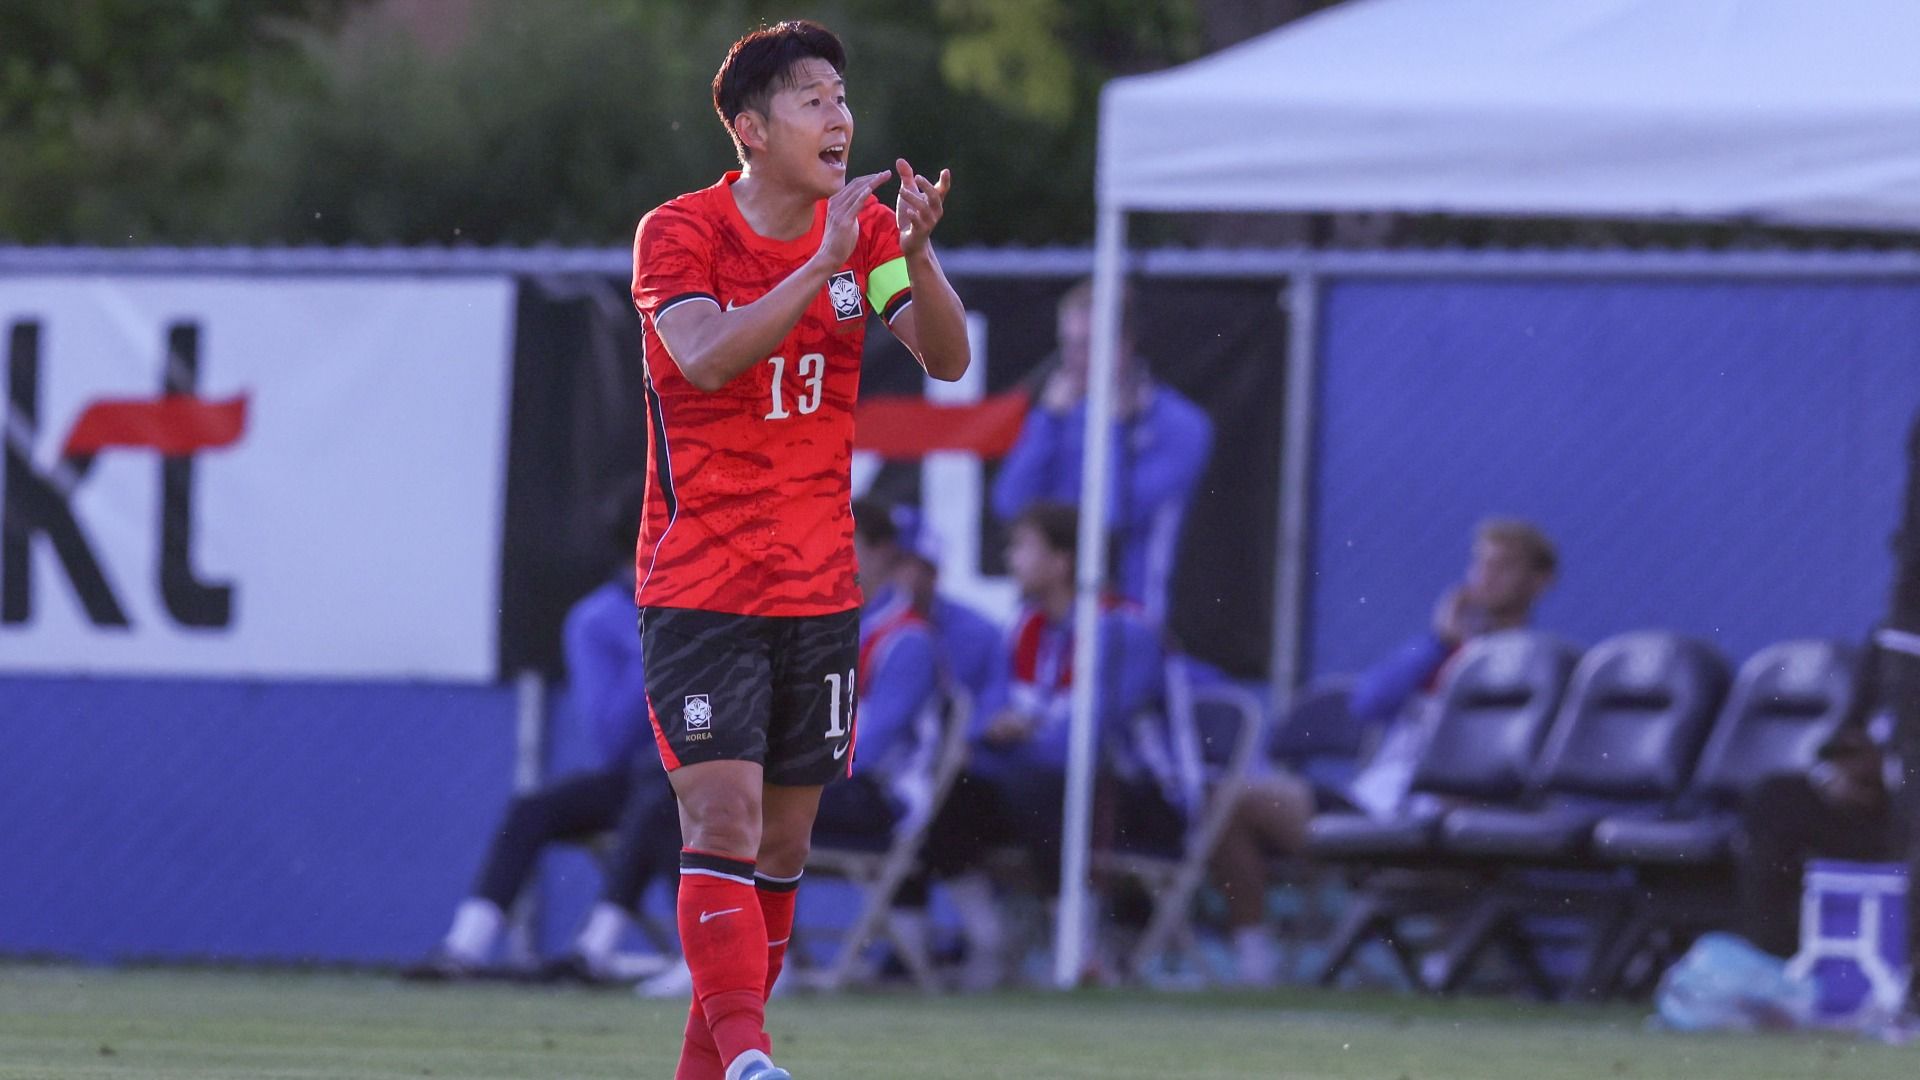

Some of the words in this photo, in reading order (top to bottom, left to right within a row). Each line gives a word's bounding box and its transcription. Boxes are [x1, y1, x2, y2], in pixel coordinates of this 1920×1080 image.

[764, 352, 825, 421] 13
[2, 321, 248, 627] kt
[685, 732, 713, 742] KOREA
